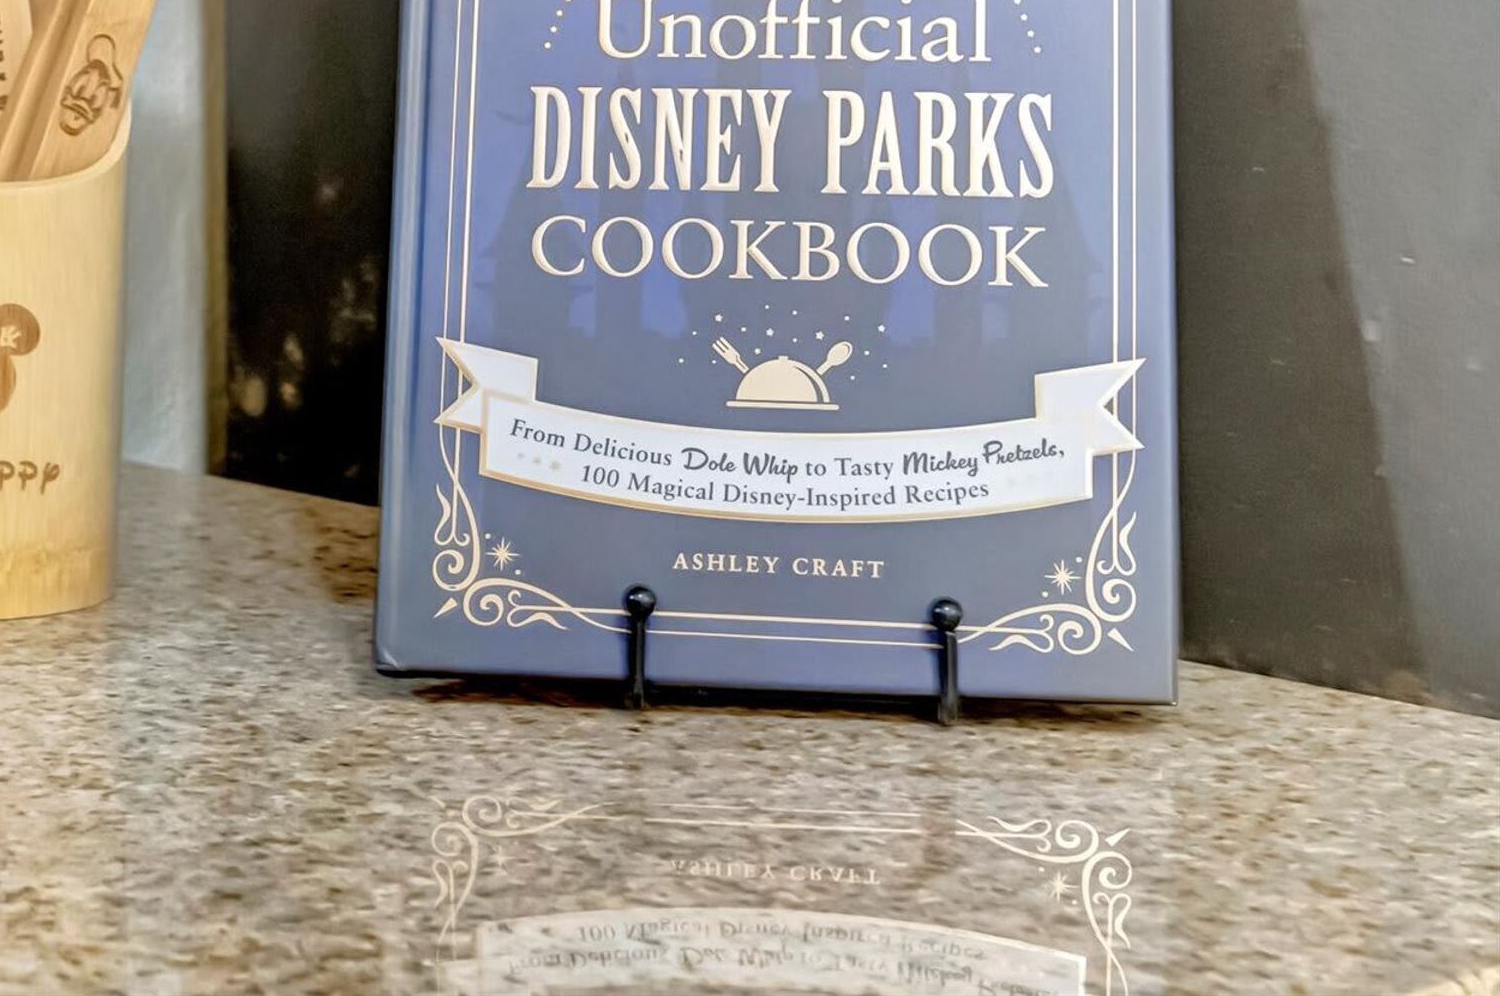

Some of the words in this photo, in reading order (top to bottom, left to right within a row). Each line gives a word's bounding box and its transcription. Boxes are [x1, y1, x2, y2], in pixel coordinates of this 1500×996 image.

[526, 86, 792, 193] DISNEY
[821, 89, 1054, 199] PARKS
[531, 214, 1049, 288] COOKBOOK
[509, 418, 566, 448] From
[573, 433, 672, 466] Delicious
[681, 447, 738, 472] Dole
[742, 452, 799, 484] Whip
[805, 460, 827, 477] to
[834, 457, 894, 479] Tasty
[903, 451, 979, 477] Mickey
[982, 438, 1065, 466] Pretzels,
[580, 464, 620, 488] 100
[627, 472, 715, 501] Magical
[722, 483, 896, 510] Disney-Inspired
[905, 480, 990, 509] Recipes
[672, 552, 780, 574] ASHLEY
[792, 557, 885, 579] CRAFT
